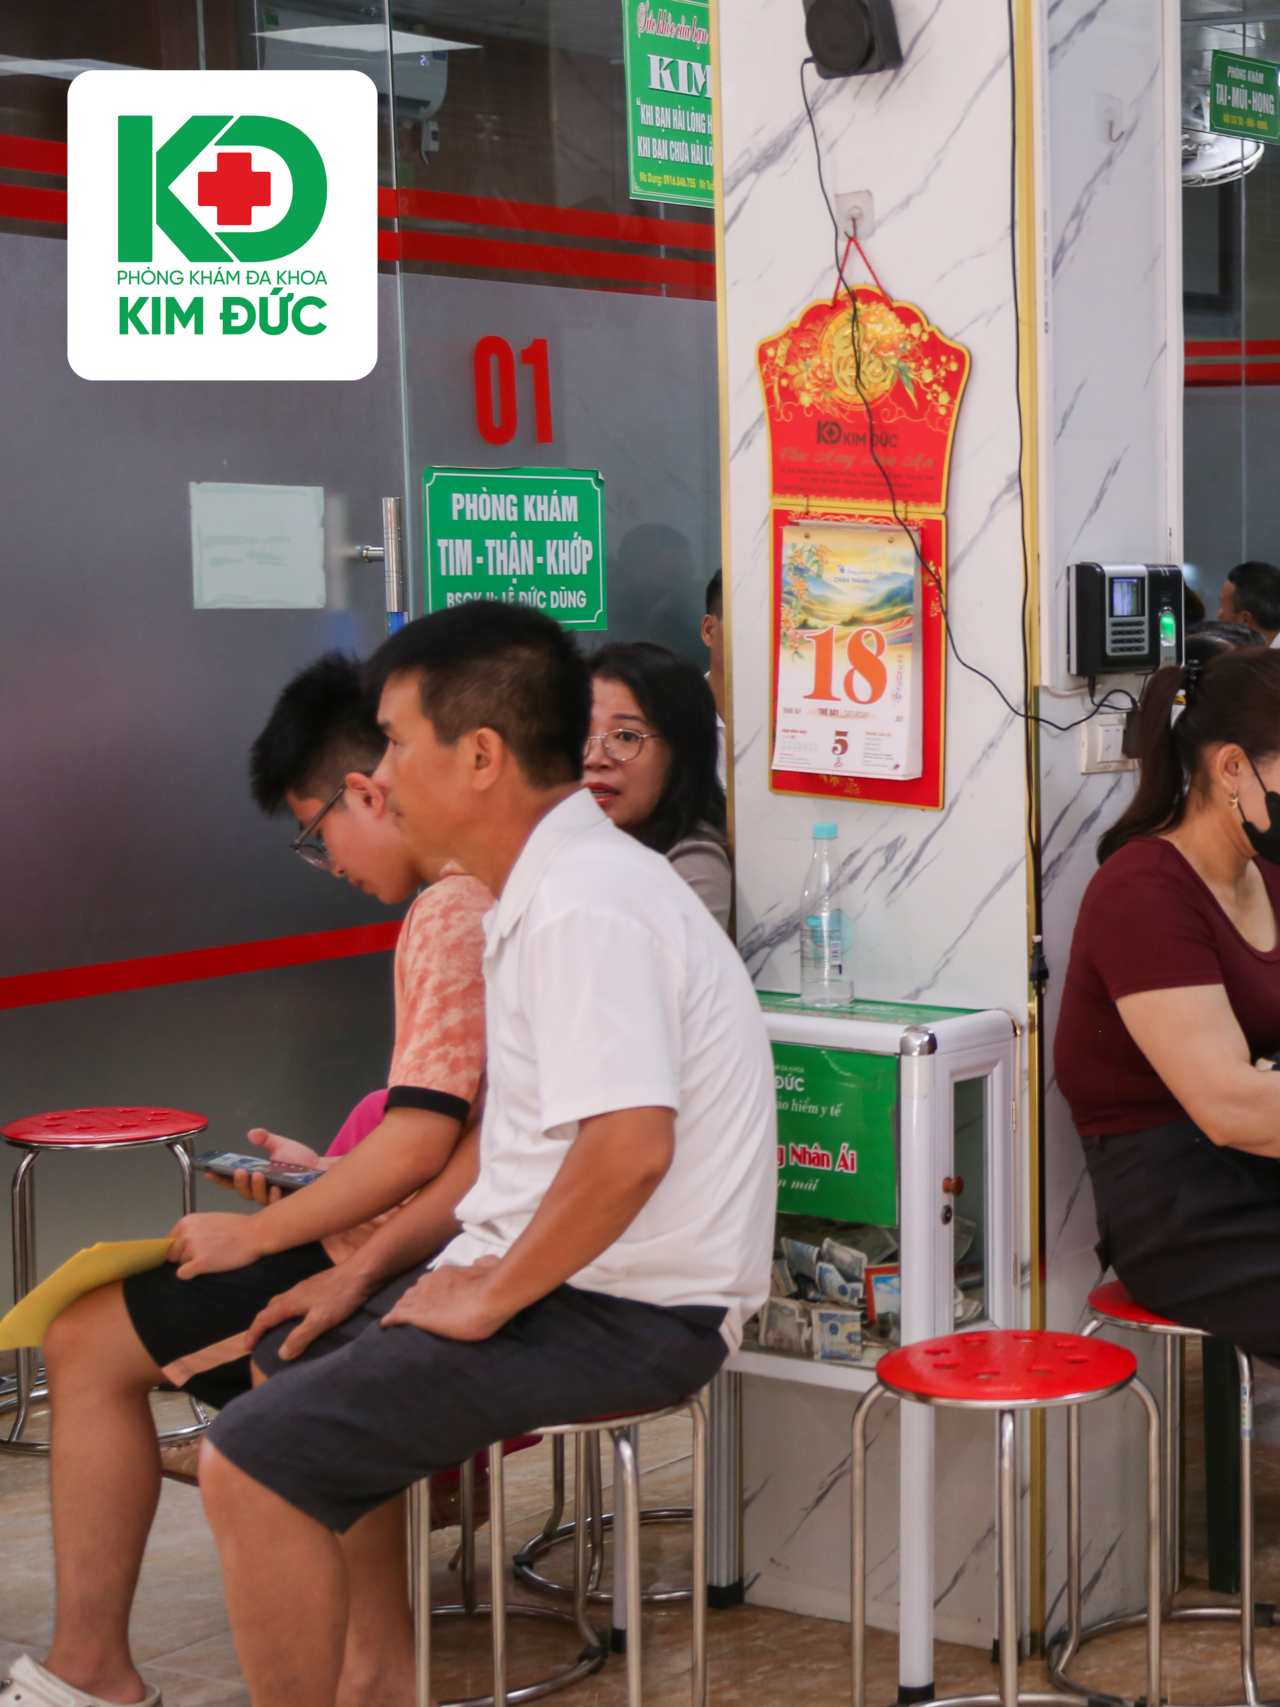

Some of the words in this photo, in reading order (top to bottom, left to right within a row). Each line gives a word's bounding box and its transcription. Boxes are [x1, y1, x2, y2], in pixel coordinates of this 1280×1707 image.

[676, 15, 691, 42] của
[692, 16, 709, 49] bạn
[647, 54, 712, 98] KIM
[1216, 83, 1227, 106] TAI
[1231, 84, 1248, 110] MŨI
[1252, 91, 1275, 117] HỌNG
[655, 106, 671, 132] BẠN
[672, 105, 685, 130] HÀI
[687, 107, 706, 134] LÒNG
[637, 136, 651, 158] KHI
[652, 137, 668, 164] BẠN
[669, 140, 689, 163] CHƯA
[690, 140, 703, 165] HÀI
[473, 335, 553, 446] 01
[843, 432, 867, 447] KIM
[452, 487, 518, 521] PHÒNG
[523, 489, 578, 522] KHÁM
[437, 539, 473, 576] TIM
[485, 531, 534, 584] THẬN
[546, 532, 593, 575] KHỚP
[518, 586, 547, 608] ĐỨC
[550, 586, 587, 608] DŨNG
[803, 625, 888, 705] 18
[831, 730, 849, 756] 5
[775, 1073, 805, 1092] ĐỨC
[777, 1096, 789, 1111] ảo
[791, 1097, 819, 1114] hiểm
[820, 1106, 828, 1118] y
[830, 1102, 844, 1117] tế
[789, 1142, 832, 1170] Nhân
[835, 1143, 857, 1174] Ái
